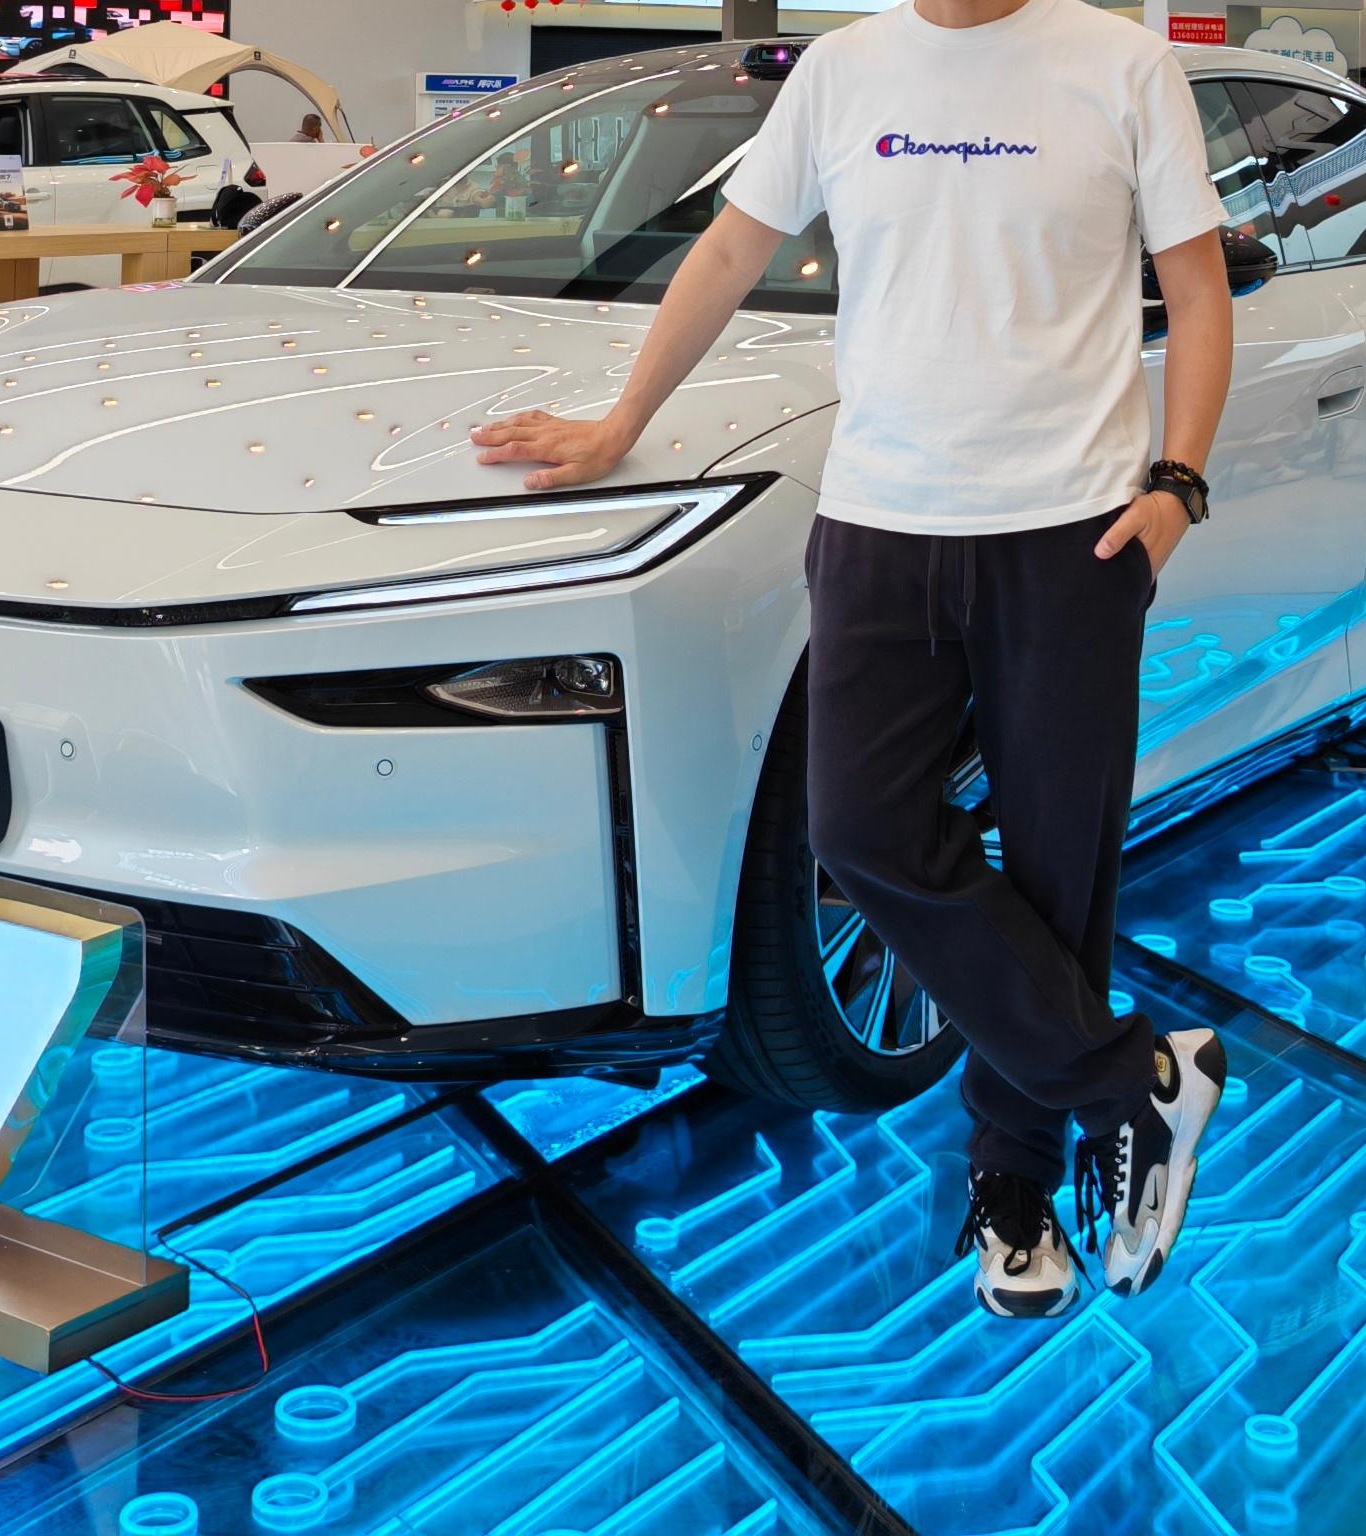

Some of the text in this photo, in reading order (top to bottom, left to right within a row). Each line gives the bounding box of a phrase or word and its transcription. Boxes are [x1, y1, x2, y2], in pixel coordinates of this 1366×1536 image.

[1257, 48, 1334, 64] 到广汽丰田
